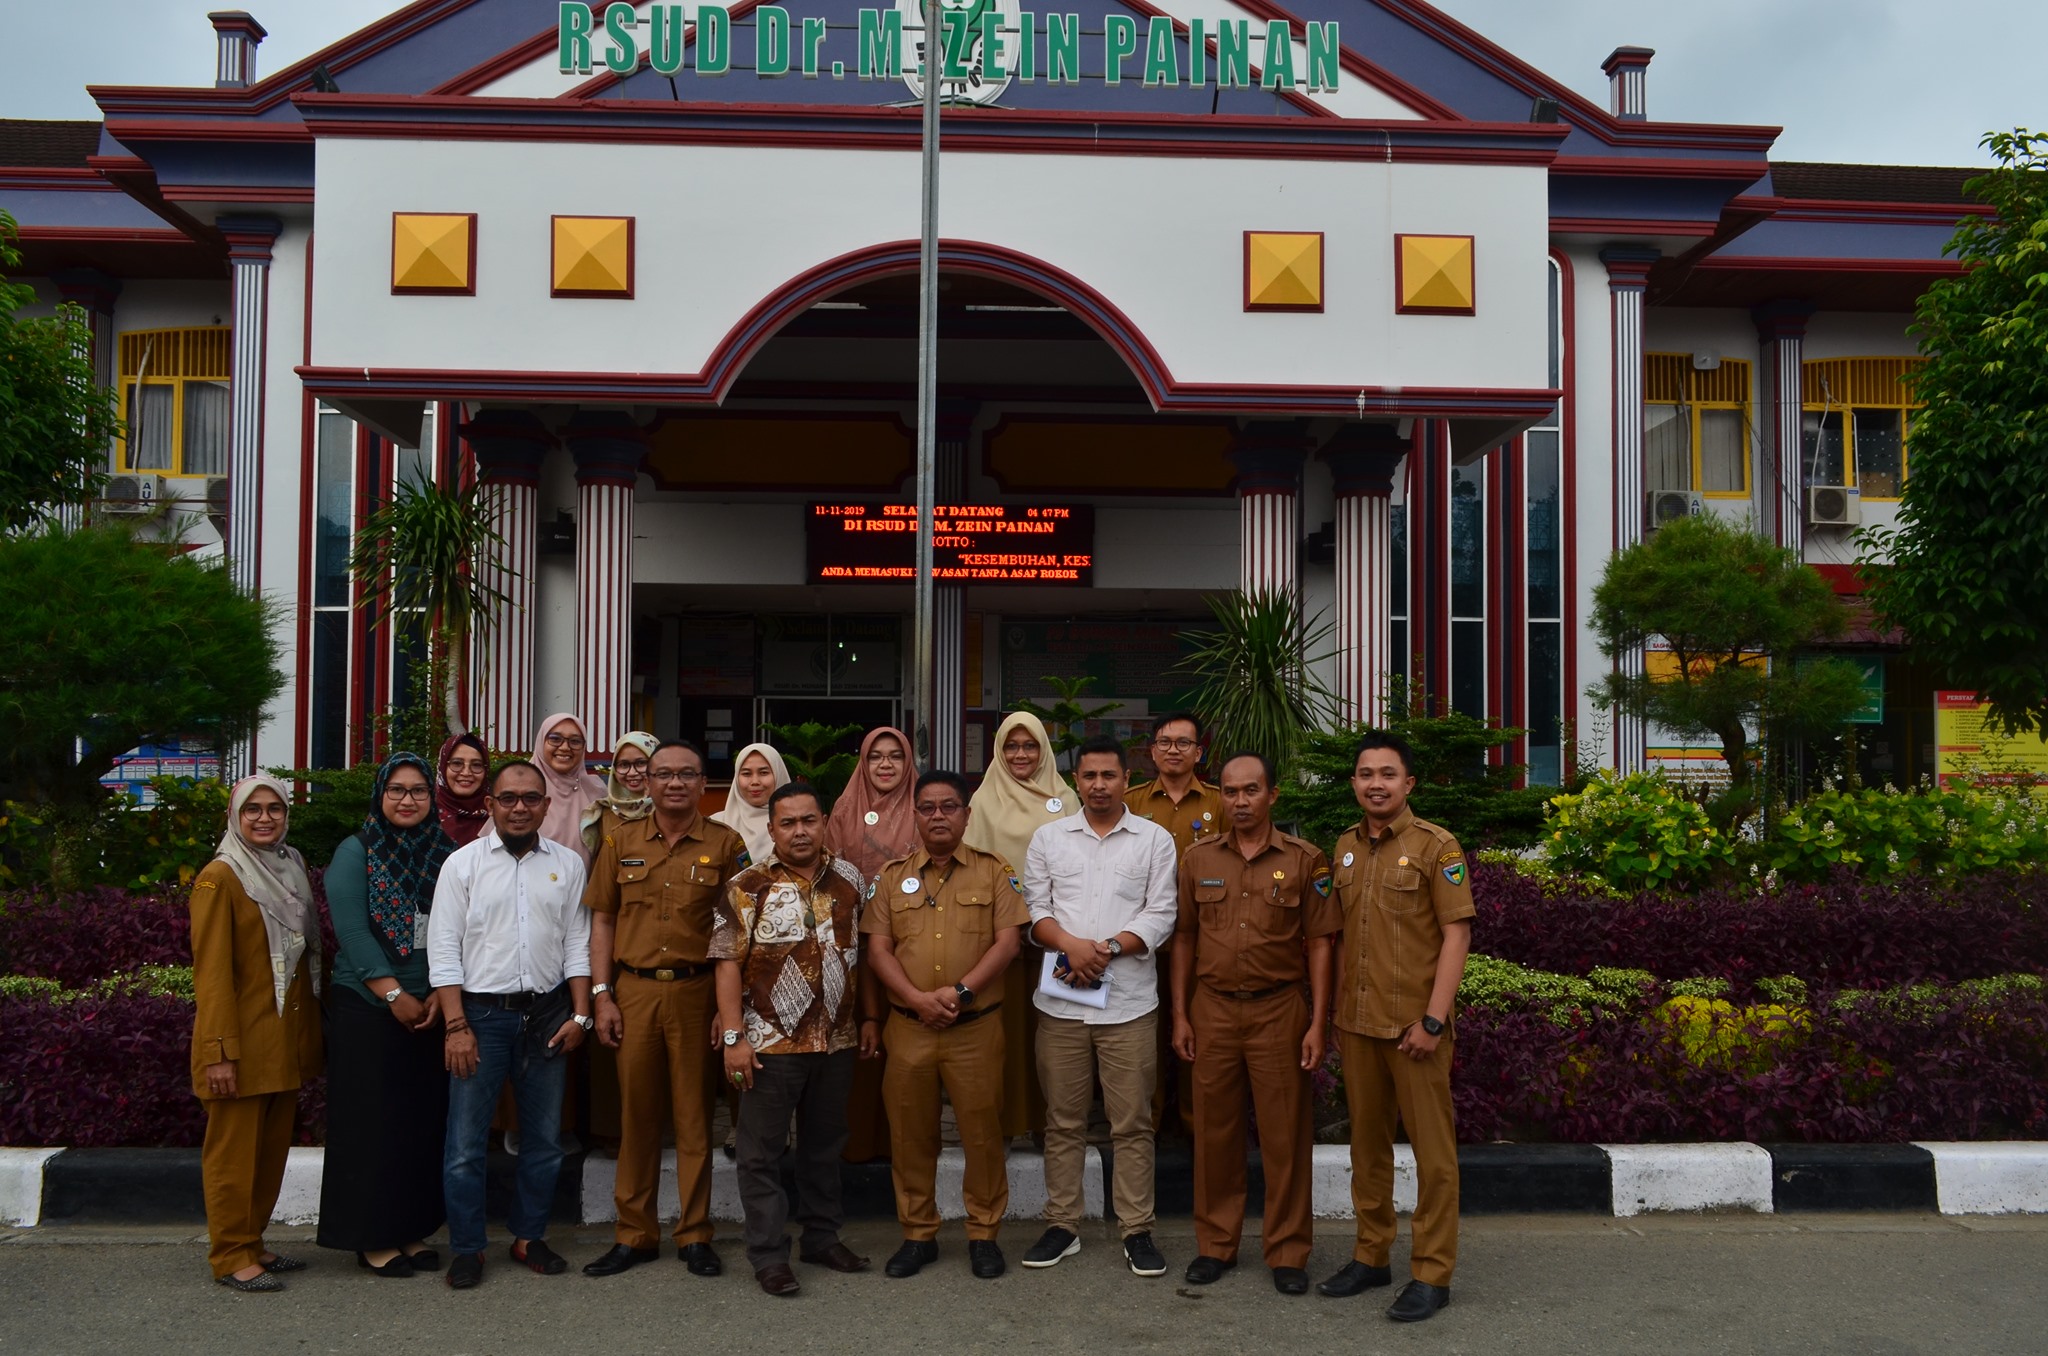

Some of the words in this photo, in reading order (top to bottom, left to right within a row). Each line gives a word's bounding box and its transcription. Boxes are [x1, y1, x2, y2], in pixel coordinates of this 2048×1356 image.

[558, 2, 729, 76] RSUD
[1104, 14, 1341, 93] PAINAN
[815, 506, 865, 515] 11-11-2019
[949, 507, 1004, 517] DATANG
[1691, 499, 1700, 516] AU
[844, 520, 863, 531] DI
[866, 520, 906, 531] RSUD
[955, 521, 992, 532] ZEIN
[995, 521, 1055, 533] PAINAN
[1063, 555, 1091, 566] KES
[821, 567, 853, 576] ANDA
[855, 567, 912, 577] MEMASUKI
[970, 568, 1008, 578] TANPA
[1010, 569, 1038, 578] ASAP
[1040, 569, 1079, 579] ROKOK
